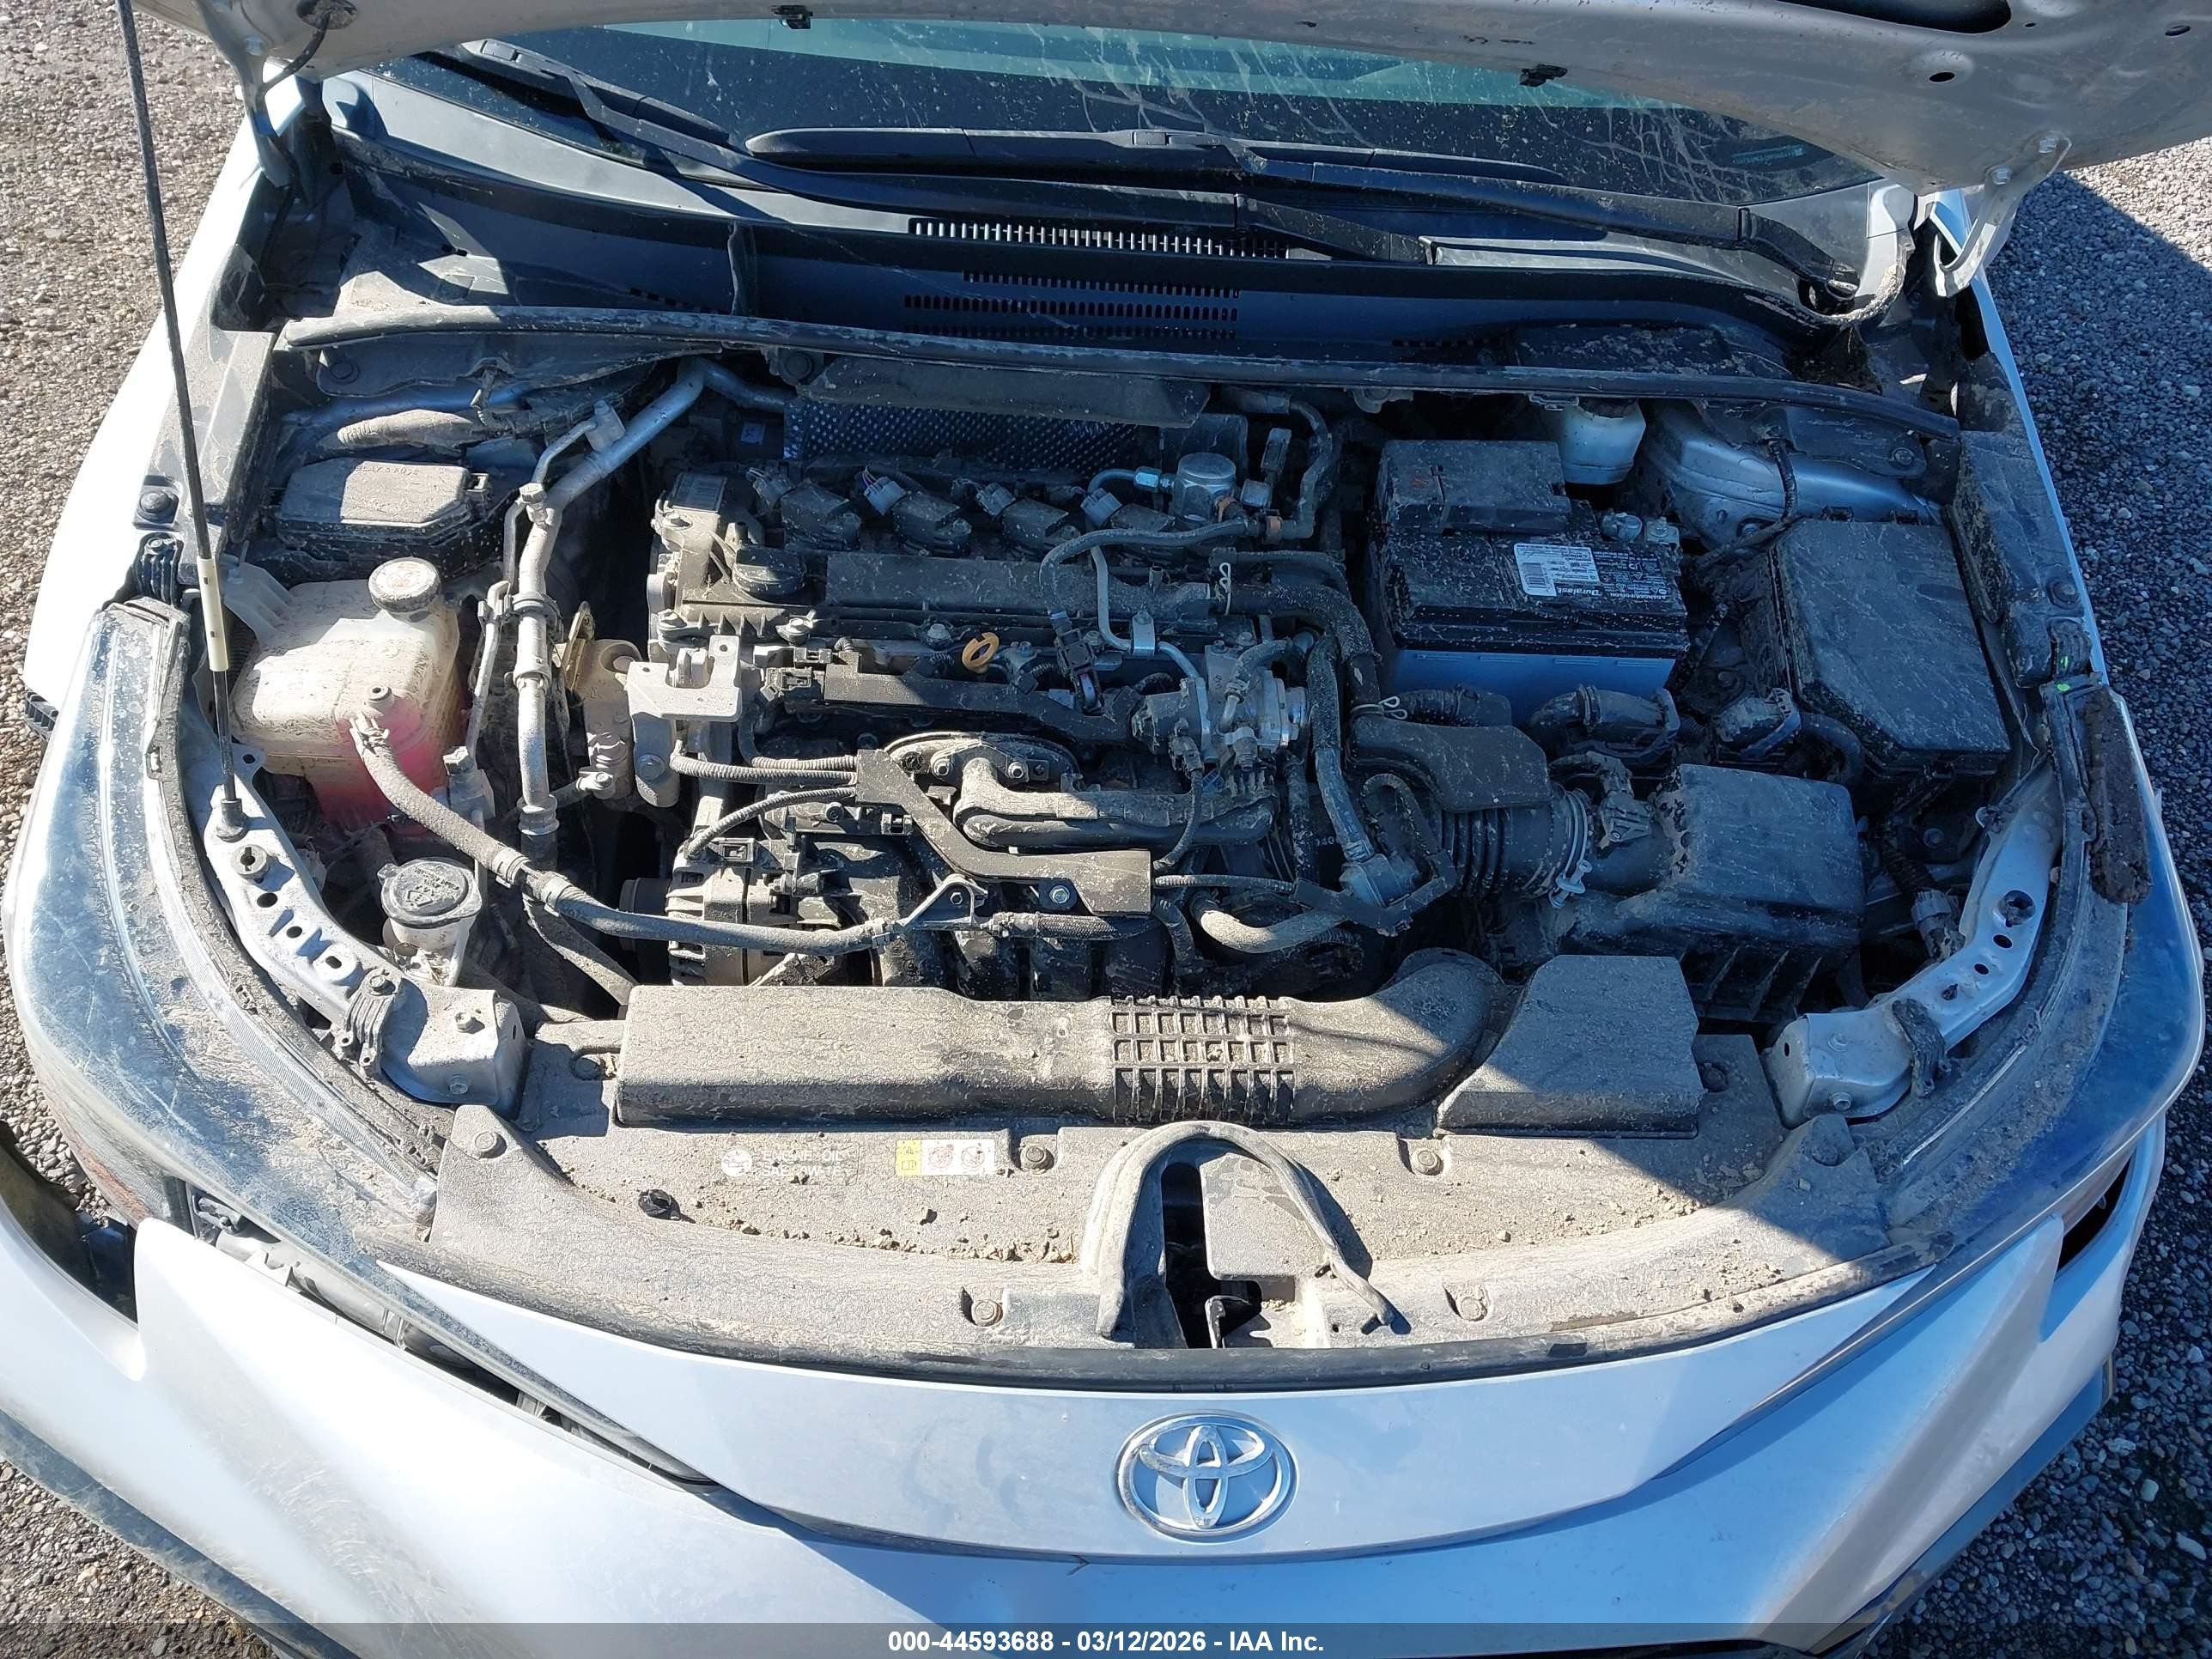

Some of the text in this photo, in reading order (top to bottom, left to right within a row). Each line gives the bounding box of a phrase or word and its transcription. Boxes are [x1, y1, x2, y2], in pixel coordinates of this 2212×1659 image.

[1557, 586, 1601, 596] Duralast
[763, 1150, 843, 1162] ENGINE OIL
[763, 1165, 788, 1176] SAE
